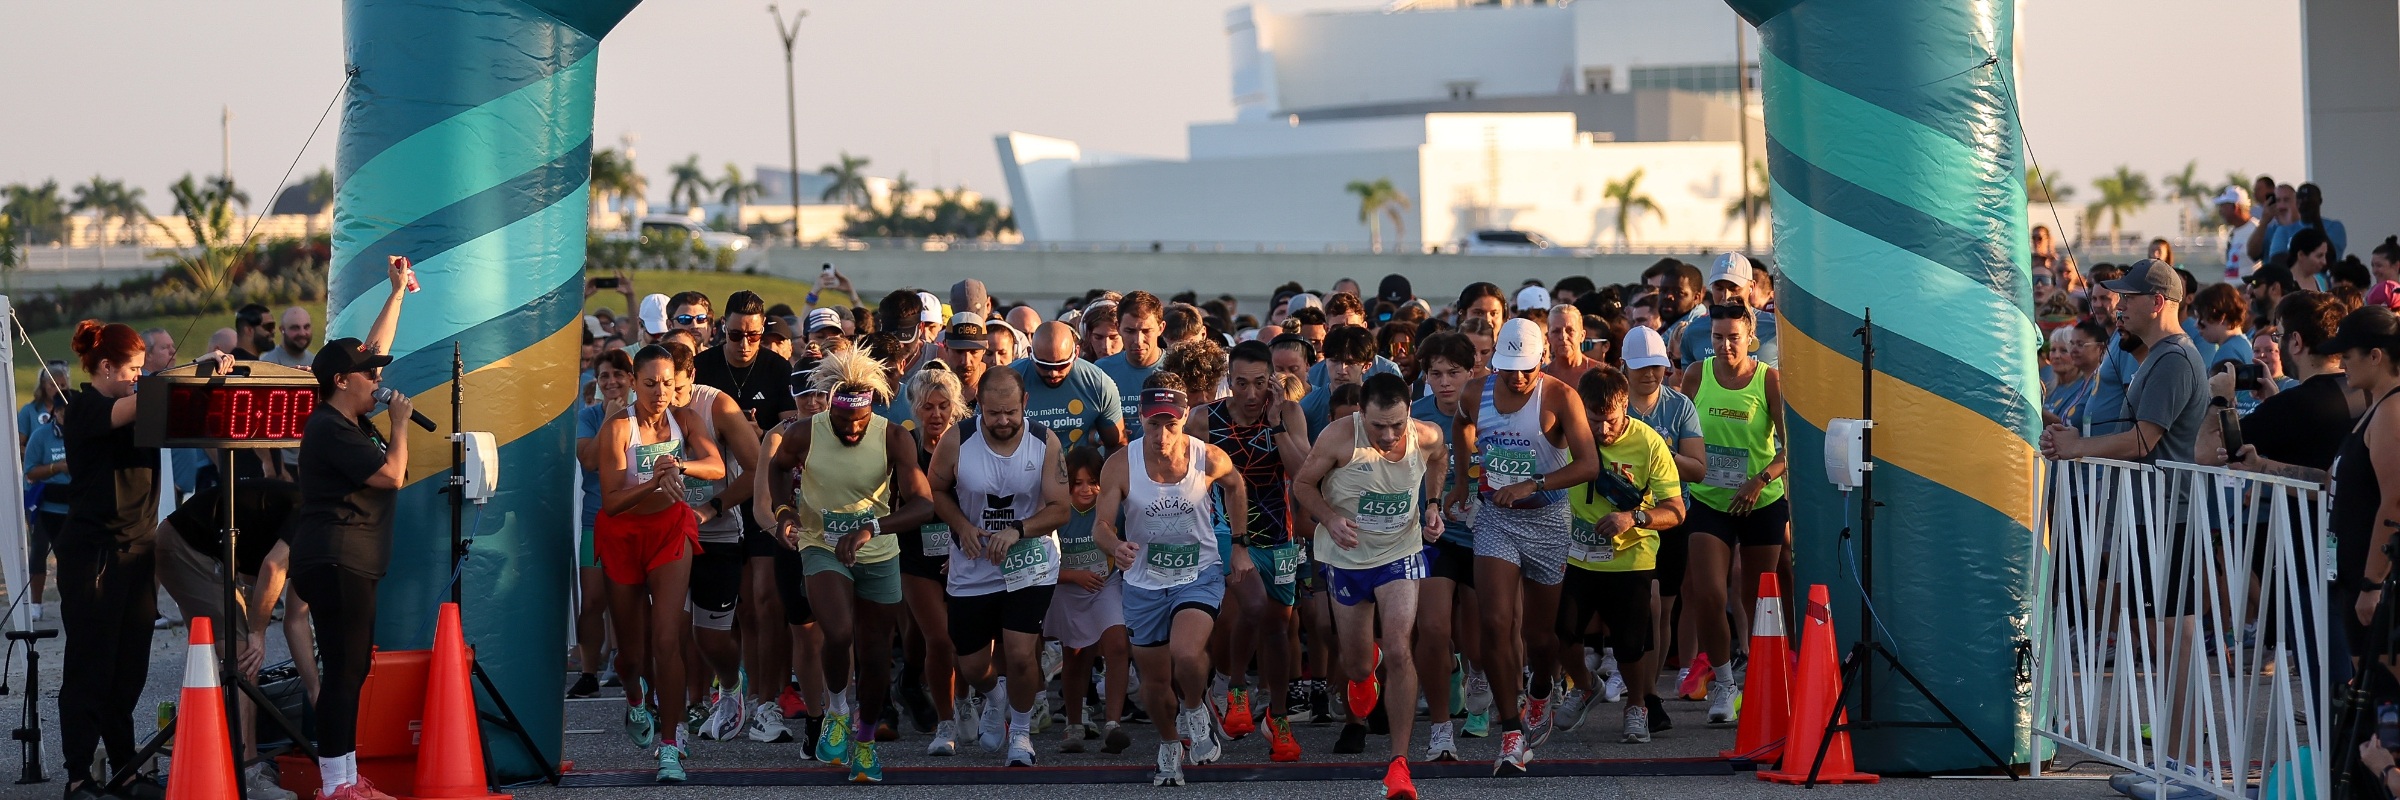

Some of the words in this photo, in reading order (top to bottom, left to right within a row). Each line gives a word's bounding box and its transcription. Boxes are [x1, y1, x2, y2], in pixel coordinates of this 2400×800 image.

[837, 395, 862, 403] RYDER
[230, 390, 314, 438] 0:00
[1024, 409, 1039, 417] You
[1040, 407, 1069, 416] matter.
[1120, 405, 1138, 415] eep
[1053, 416, 1084, 429] going.
[1498, 448, 1511, 457] Life
[1489, 457, 1531, 475] 4622
[1710, 455, 1740, 469] 1123
[1145, 499, 1194, 517] CHICAGO
[1362, 500, 1408, 515] 4569
[929, 532, 951, 547] 99
[1573, 528, 1607, 545] 4645
[1004, 548, 1043, 570] 4565
[1067, 551, 1099, 566] 1120
[1151, 552, 1195, 567] 4561
